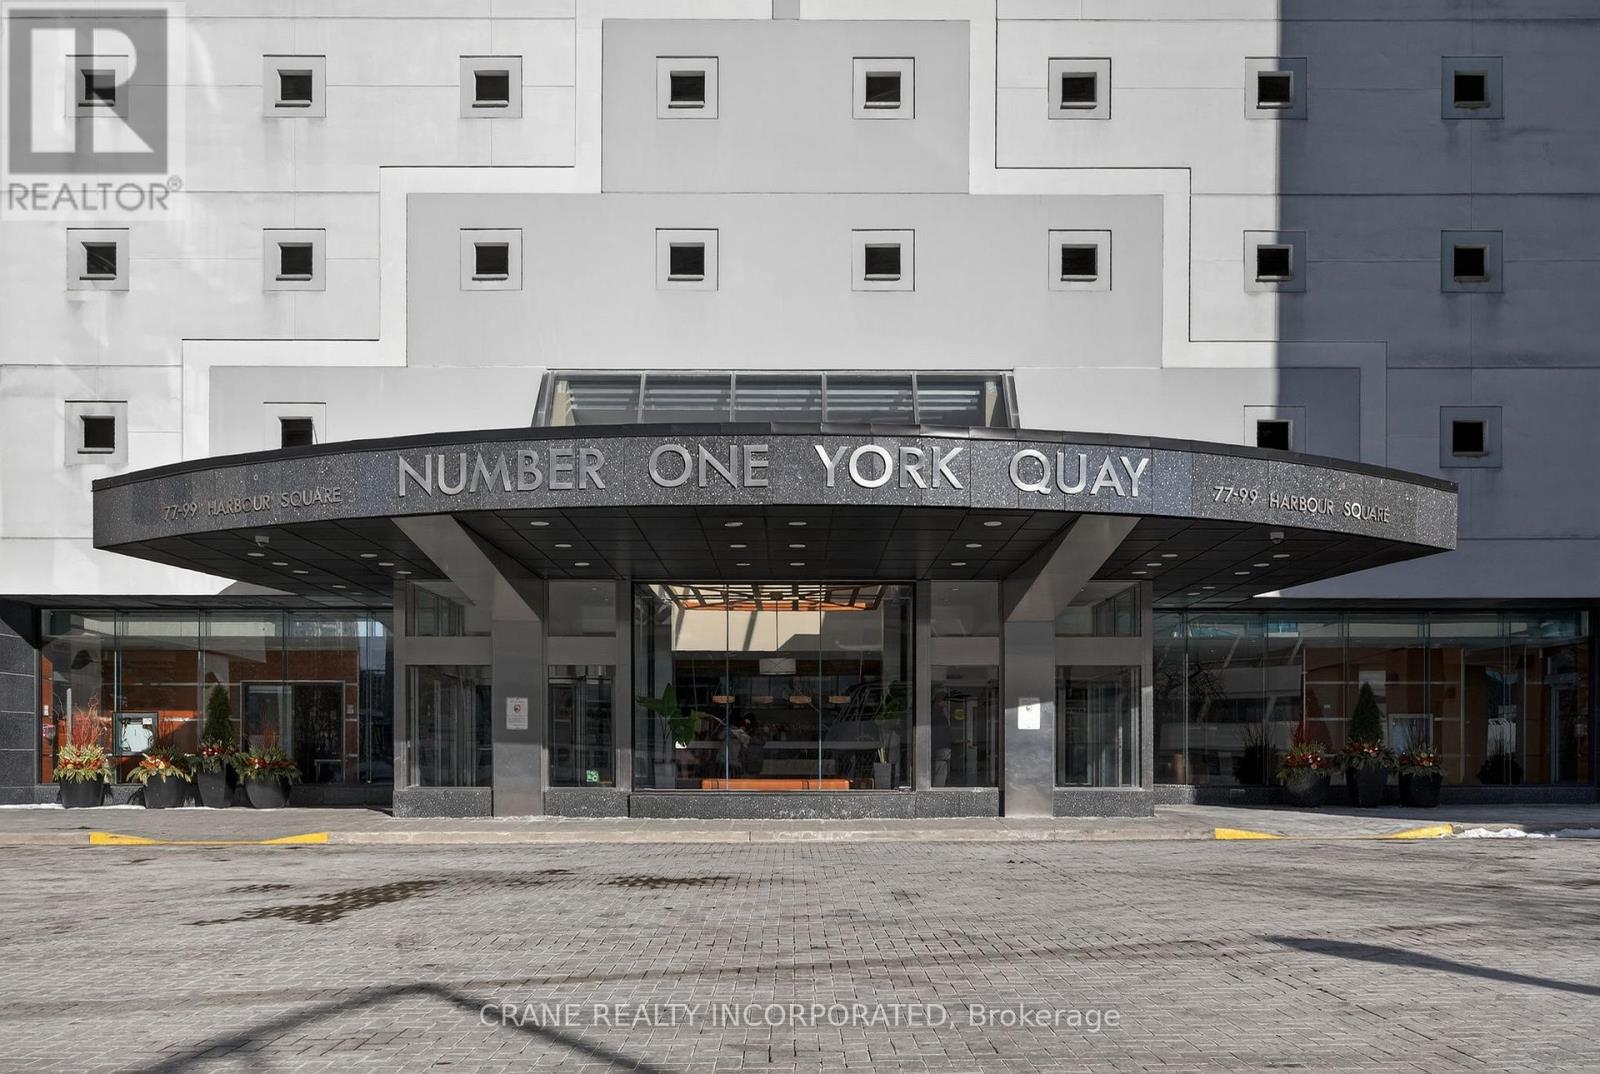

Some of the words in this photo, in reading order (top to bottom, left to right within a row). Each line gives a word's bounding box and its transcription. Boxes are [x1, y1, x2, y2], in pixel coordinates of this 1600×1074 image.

[399, 447, 606, 497] NUMBER
[648, 444, 769, 489] ONE
[814, 444, 964, 490] YORK
[1008, 448, 1150, 498] QUAY
[163, 502, 199, 521] 77-99
[207, 493, 272, 516] HARBOUR
[280, 487, 343, 508] SQUARE
[1213, 486, 1258, 504] 77-99
[1269, 493, 1334, 515] HARBOUR
[1343, 502, 1390, 523] SQUARE
